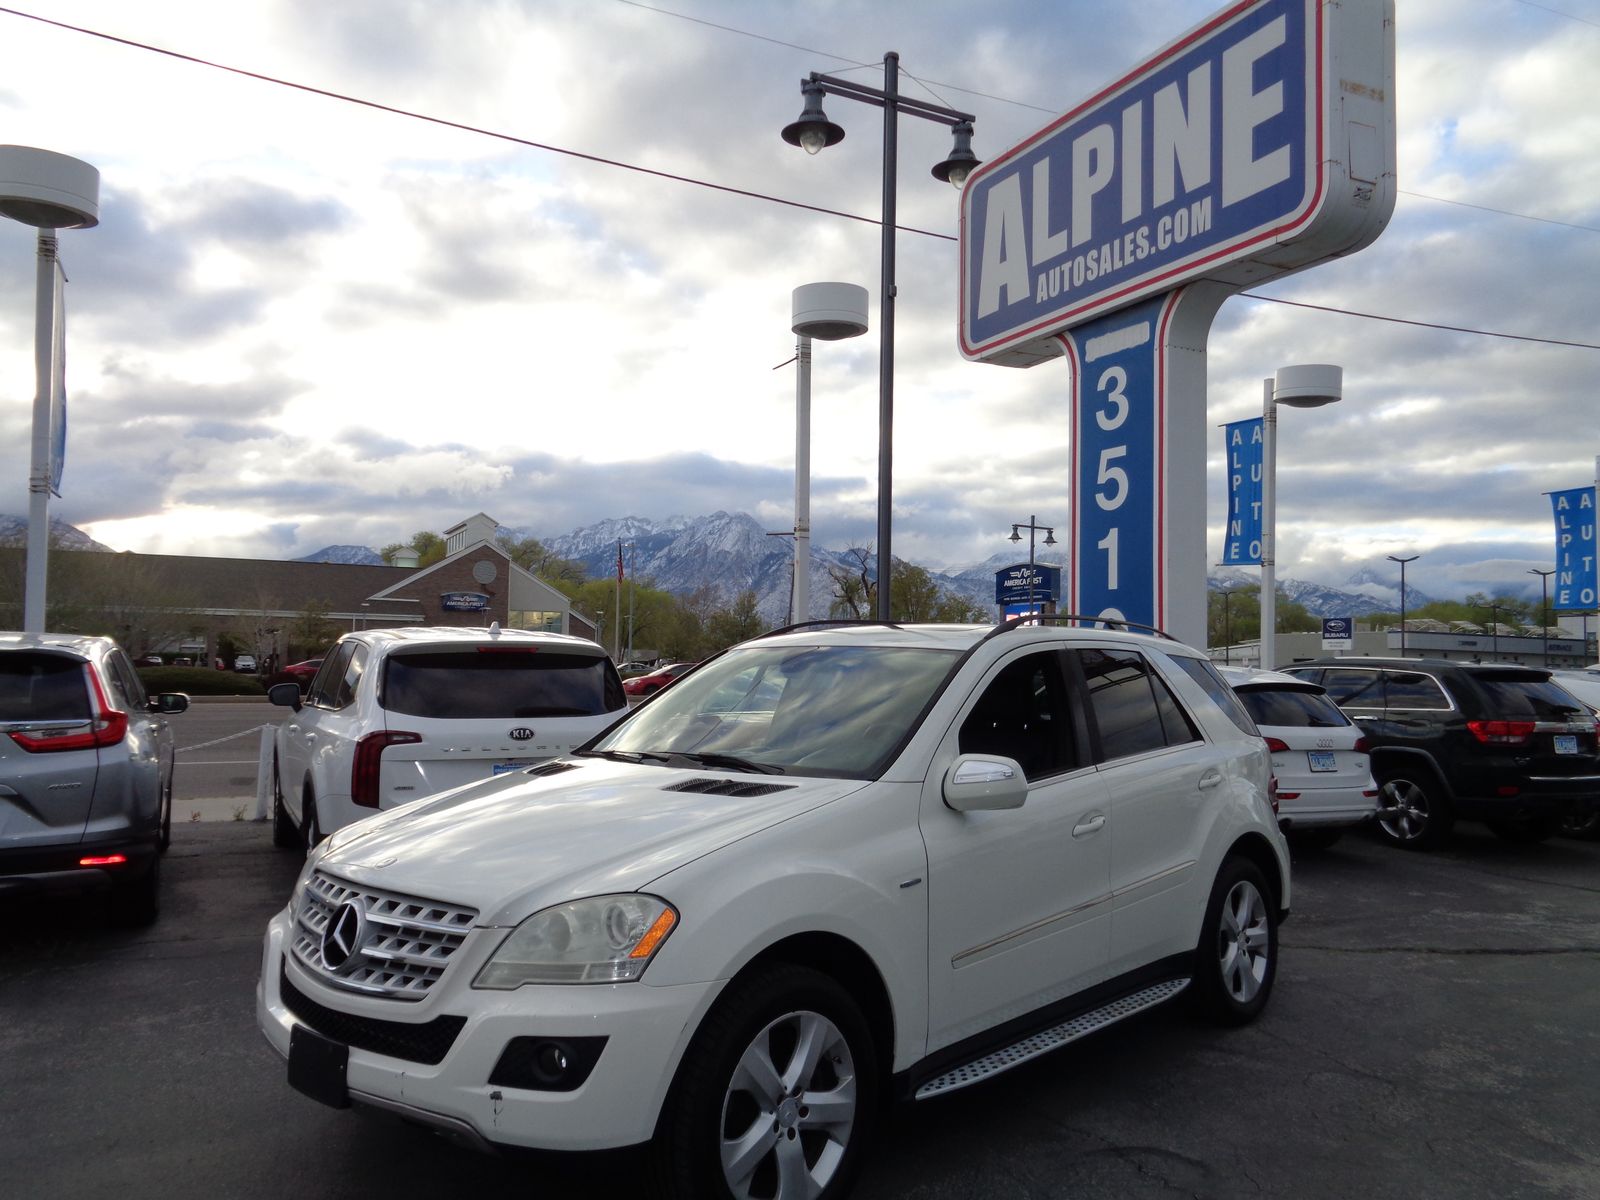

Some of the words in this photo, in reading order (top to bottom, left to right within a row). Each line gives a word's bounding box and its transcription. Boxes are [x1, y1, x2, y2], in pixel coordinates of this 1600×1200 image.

[977, 13, 1291, 320] ALPINE
[1035, 196, 1211, 304] AUTOSALES.COM
[1230, 428, 1243, 560] ALPINE
[1249, 424, 1263, 559] AUTO
[1003, 578, 1026, 587] AMERICA
[1557, 495, 1573, 605] ALPINE
[1579, 492, 1595, 604] AUTO
[512, 729, 532, 739] KIA
